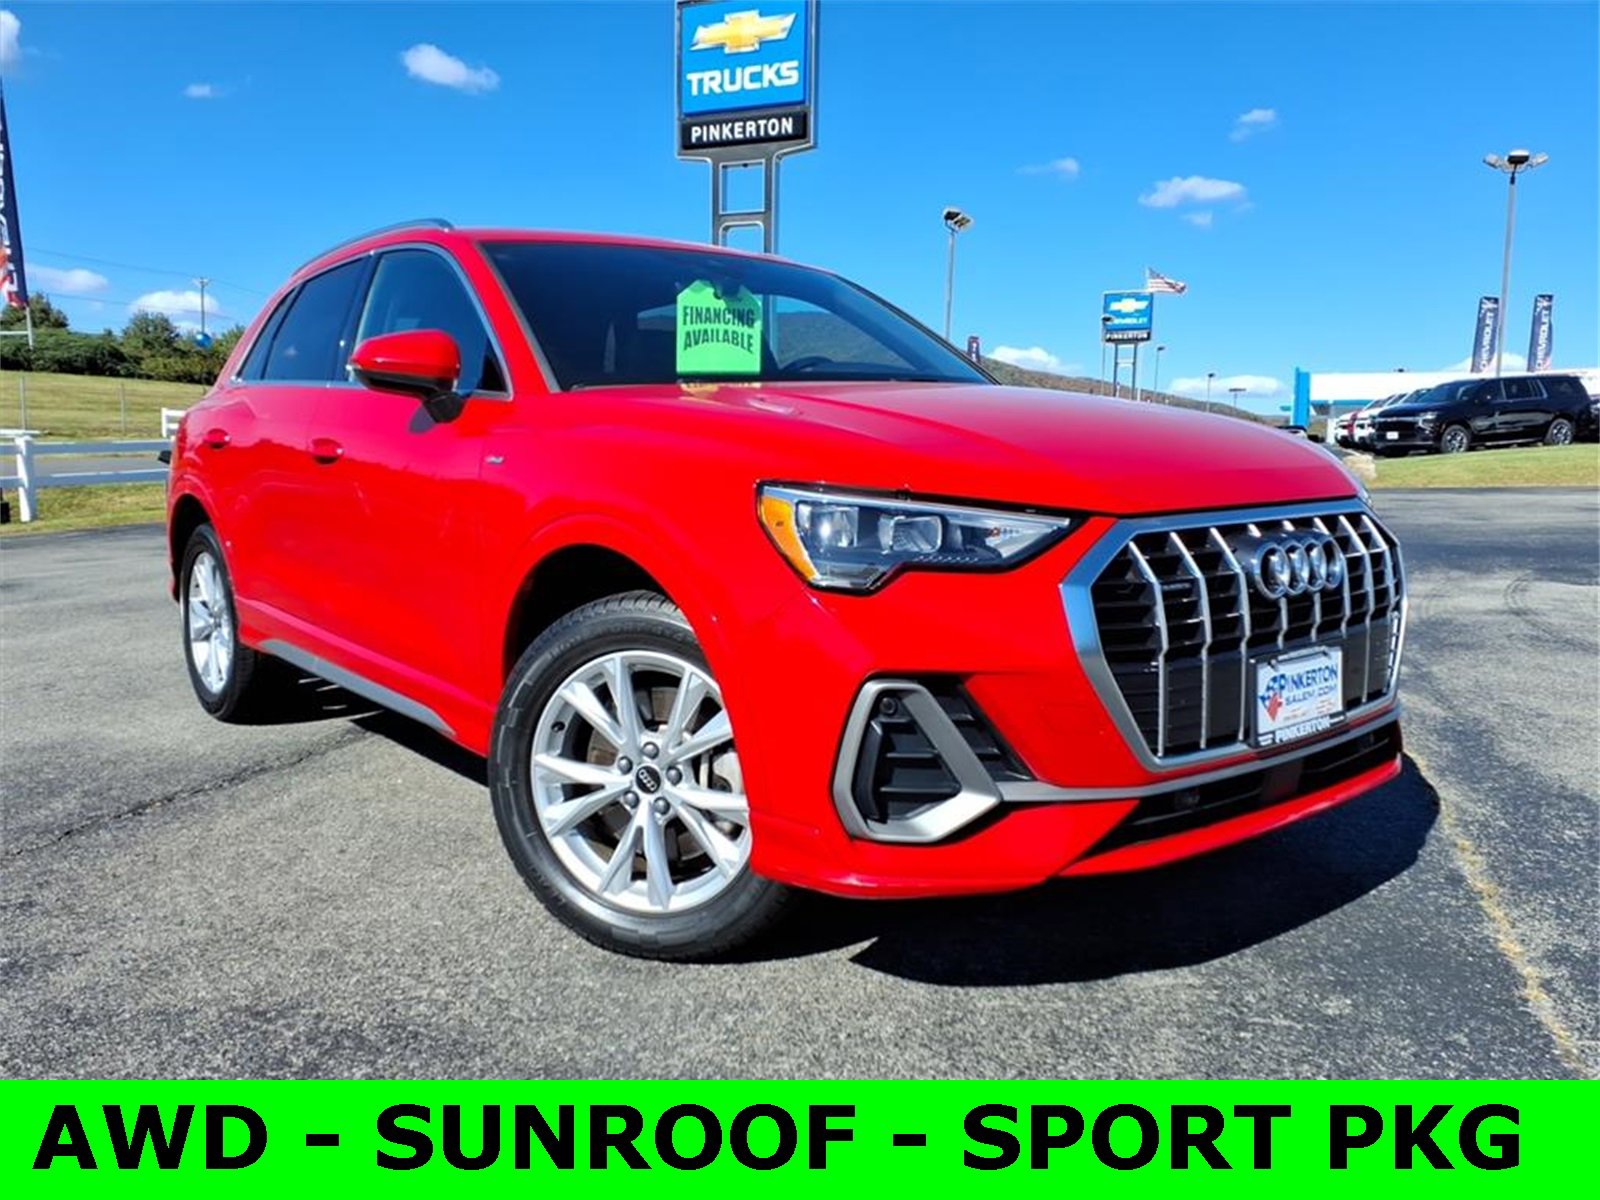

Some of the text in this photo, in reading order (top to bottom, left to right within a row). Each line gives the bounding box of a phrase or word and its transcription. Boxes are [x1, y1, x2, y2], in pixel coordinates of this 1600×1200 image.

[686, 60, 800, 97] TRUCKS
[690, 116, 793, 143] PINKERTON
[683, 305, 755, 329] FINANCING
[683, 328, 754, 355] AVAILABLE
[1105, 331, 1149, 341] PINKERTON
[1275, 664, 1338, 695] PINKERTON
[1274, 714, 1331, 743] PINKERTON
